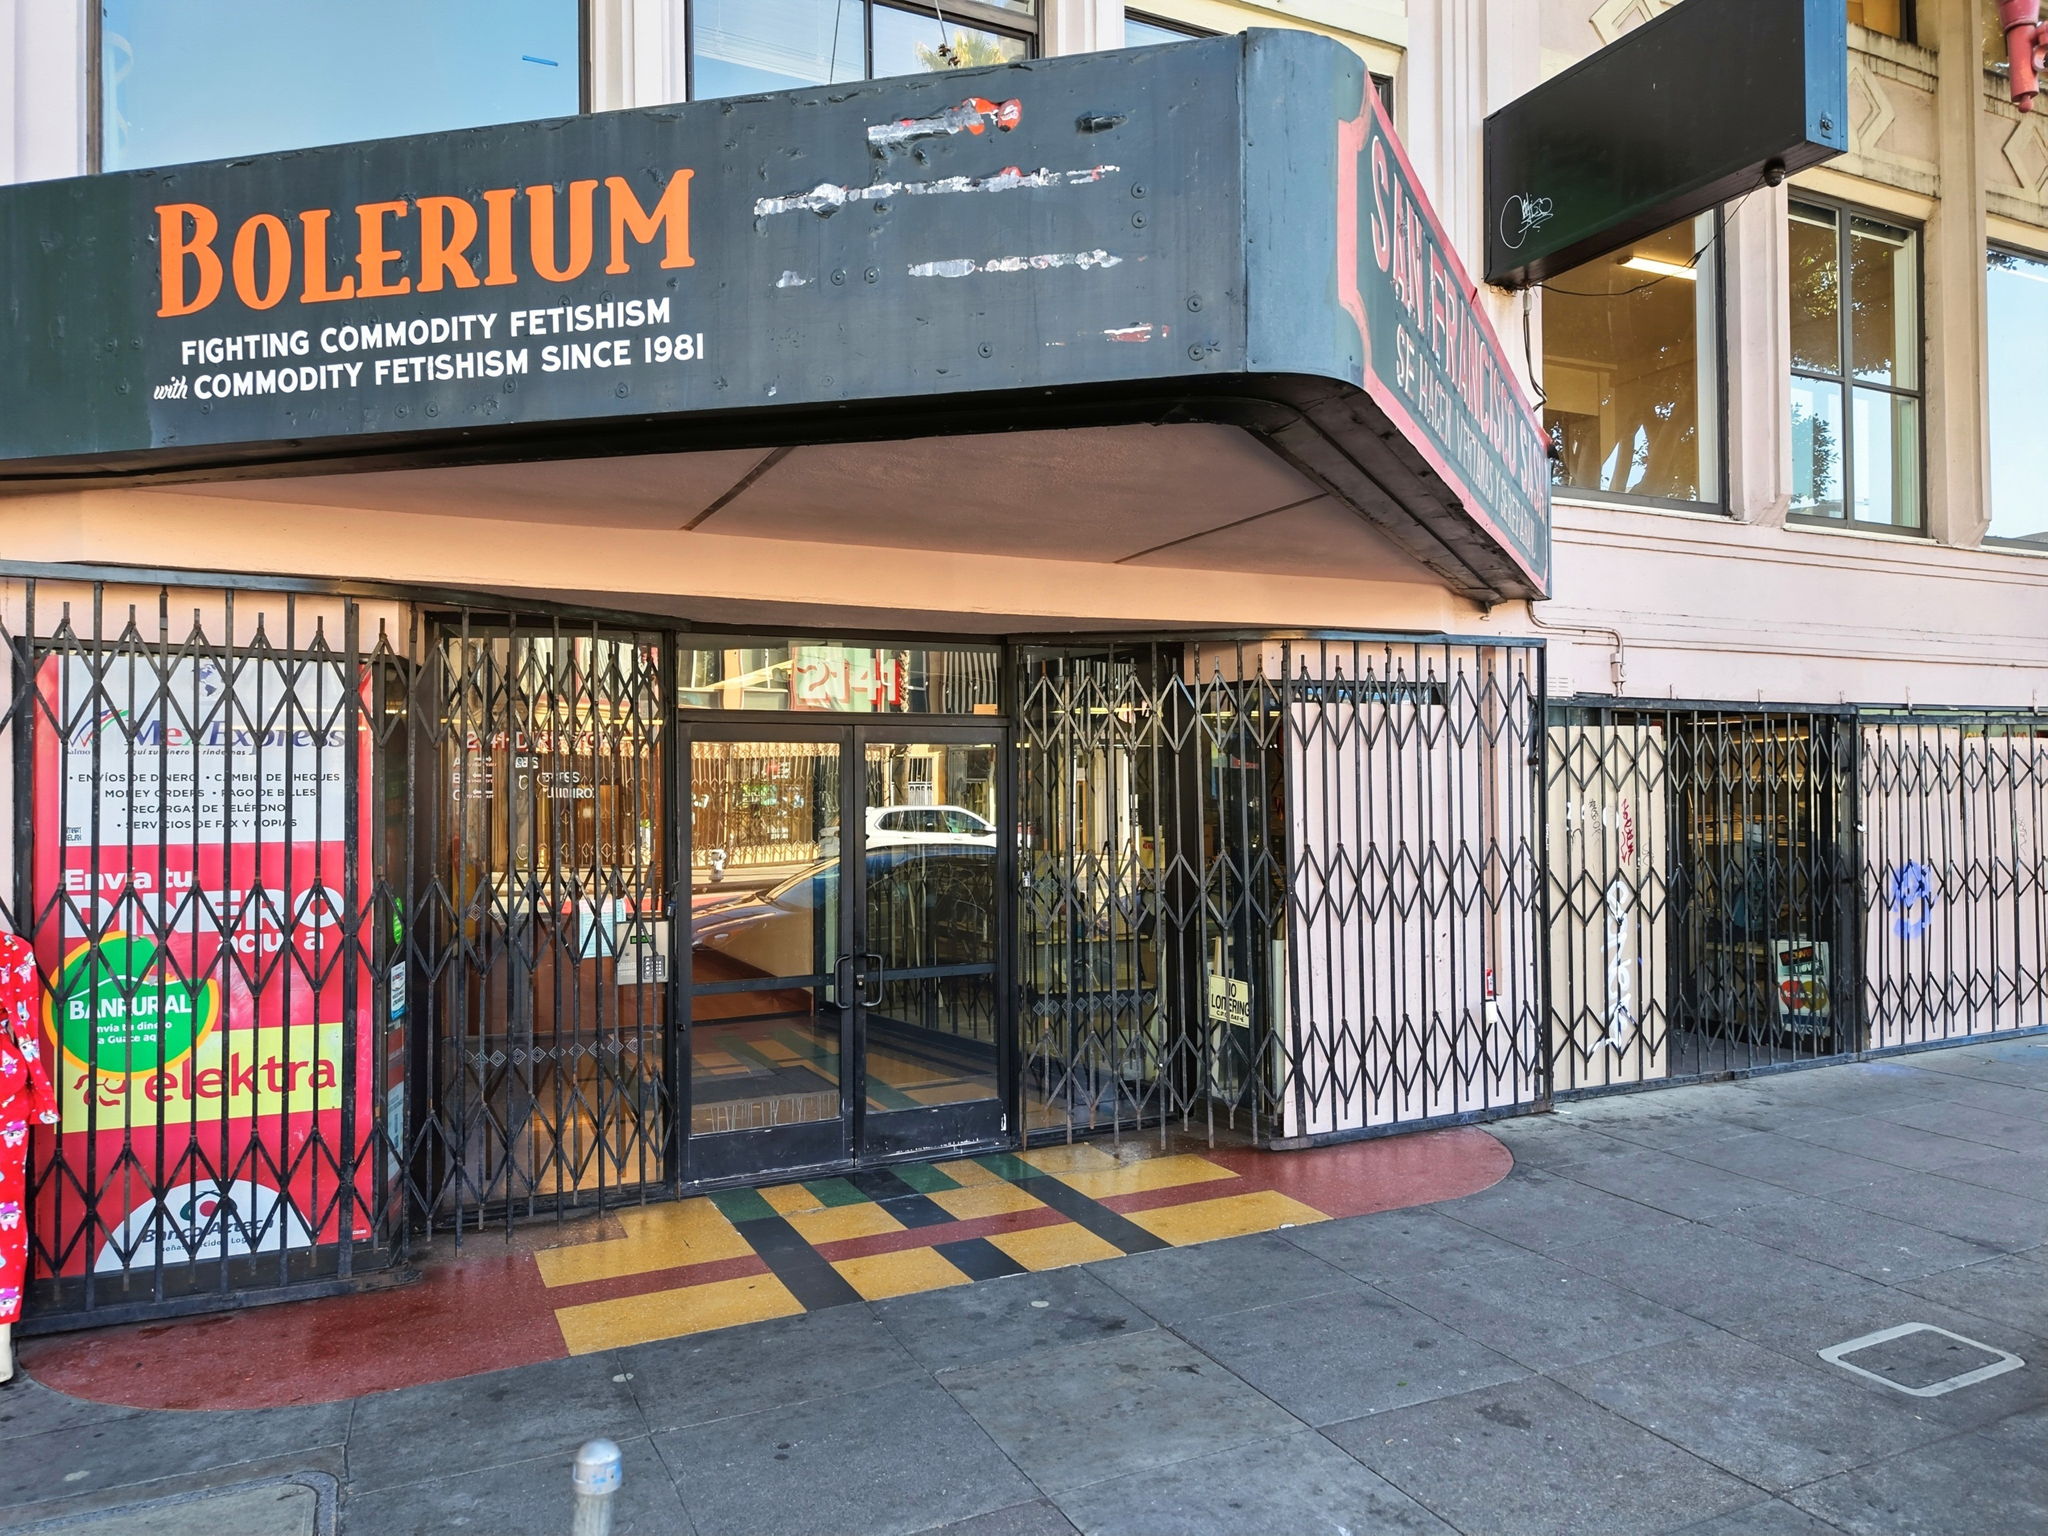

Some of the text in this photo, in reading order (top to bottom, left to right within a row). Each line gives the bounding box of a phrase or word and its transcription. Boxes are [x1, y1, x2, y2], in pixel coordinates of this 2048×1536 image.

[155, 168, 695, 318] BOLERIUM
[1371, 135, 1425, 333] SAN
[1430, 243, 1518, 478] FRANCISCO
[181, 296, 671, 366] FIGHTING COMMODITY FETISHISM
[154, 332, 704, 401] with COMMODITY FETISHISM SINCE 1981
[1418, 353, 1452, 450] HACEN
[797, 658, 896, 701] 2141
[161, 748, 190, 756] inero
[105, 789, 150, 798] MOEY
[150, 774, 199, 782] DNERO
[214, 773, 263, 782] CMBI
[266, 773, 282, 782] DE
[285, 773, 340, 782] HEQUES
[126, 820, 191, 829] ERVCIOS
[215, 820, 238, 829] FX
[242, 820, 250, 828] Y
[253, 818, 297, 828] OPIS
[202, 805, 218, 813] DE
[222, 802, 287, 813] ELÉFONO
[65, 867, 193, 891] Enva tu
[64, 886, 345, 938] DINERO
[217, 931, 324, 957] aqu a
[91, 1024, 119, 1033] nvia
[137, 1021, 172, 1031] dineo
[144, 1052, 337, 1104] elektra
